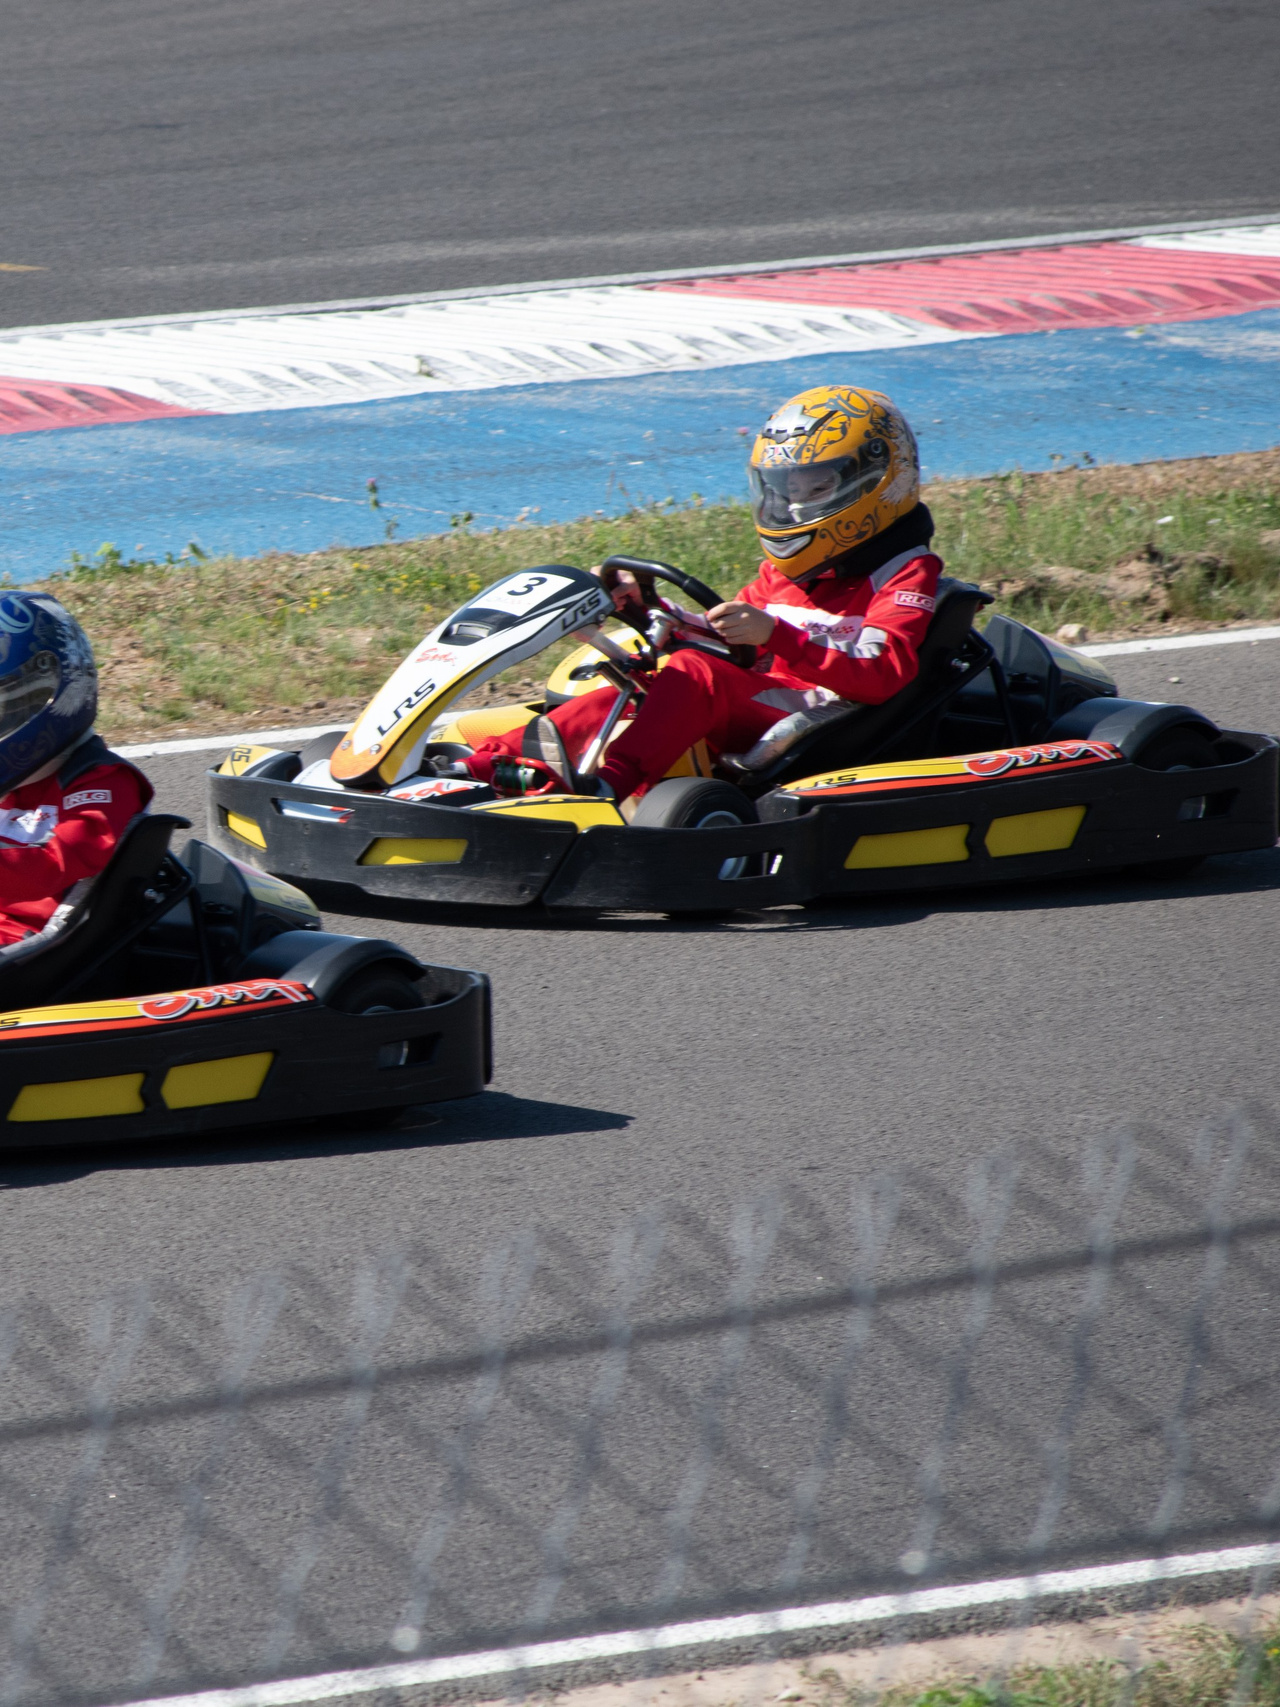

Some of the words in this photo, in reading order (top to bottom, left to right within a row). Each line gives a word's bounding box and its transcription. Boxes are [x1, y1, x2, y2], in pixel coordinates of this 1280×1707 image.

[507, 576, 548, 596] 3
[899, 593, 934, 608] RLG
[561, 591, 602, 631] LRS
[377, 678, 436, 736] LRS
